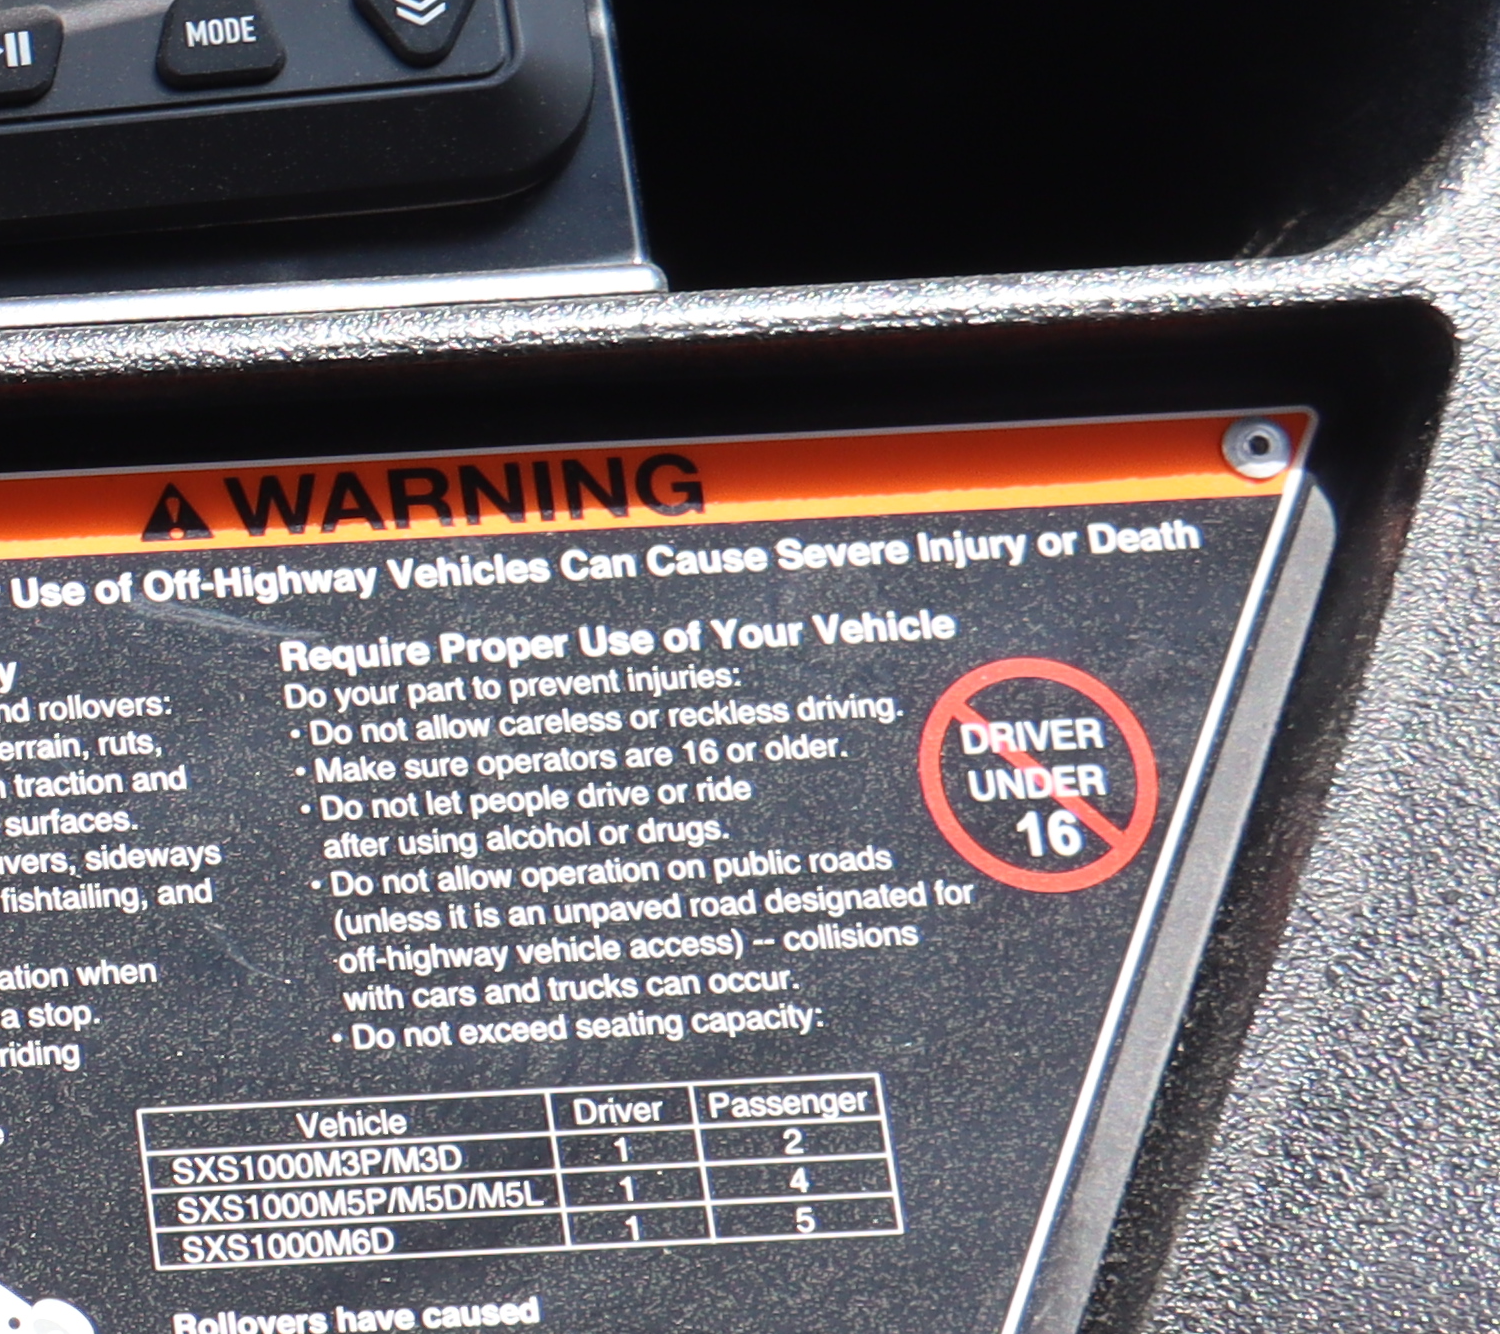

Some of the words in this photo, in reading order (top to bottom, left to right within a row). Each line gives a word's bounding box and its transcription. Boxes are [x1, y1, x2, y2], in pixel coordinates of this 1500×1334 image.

[185, 15, 256, 47] MODE
[222, 452, 706, 537] WARNING
[11, 577, 85, 609] Use
[95, 572, 133, 604] of
[143, 565, 377, 604] Off-Highway
[387, 553, 551, 589] Vehicles
[561, 549, 637, 581] Can
[647, 545, 768, 576] Cause
[776, 538, 909, 570] Severe
[917, 530, 1026, 569] Injury
[1037, 532, 1077, 557] or
[1087, 520, 1200, 554] Death
[280, 636, 430, 676] Require
[439, 633, 568, 668] Proper
[579, 625, 654, 657] Use
[663, 620, 701, 653] of
[710, 618, 803, 649] Your
[812, 609, 955, 644] Vehicle
[39, 694, 174, 721] rollovers:
[284, 683, 327, 709] Do
[334, 684, 399, 713] your
[408, 677, 466, 709] part
[472, 676, 501, 700] to
[509, 669, 620, 704] prevent
[628, 668, 741, 697] injuries:
[98, 731, 162, 757] ruts,
[310, 720, 352, 745] Do
[361, 718, 408, 743] not
[416, 714, 490, 741] allow
[499, 708, 622, 736] careless
[630, 709, 659, 730] or
[668, 700, 790, 727] reckless
[797, 695, 903, 724] driving.
[959, 717, 1104, 755] DRIVER
[315, 756, 396, 783] Make
[404, 757, 468, 779] sure
[477, 747, 617, 780] operators
[625, 746, 673, 768] are
[683, 739, 719, 764] 16
[727, 742, 756, 763] or
[765, 734, 847, 761] older.
[967, 764, 1108, 802] UNDER
[1016, 809, 1084, 857] 16
[85, 844, 222, 872] sideways
[76, 959, 157, 986] when
[295, 1109, 408, 1140] Vehicle
[572, 1097, 663, 1126] Driver
[707, 1090, 868, 1120] Passenger
[172, 1144, 464, 1185] SXS1000M3P/M3D
[613, 1137, 629, 1162] 1
[782, 1128, 804, 1155] 2
[176, 1180, 544, 1224] SXS1000M5P/M5D/M5L
[619, 1176, 634, 1202] 1
[789, 1167, 809, 1193] 4
[182, 1226, 395, 1264] SXS1000M6D
[625, 1216, 640, 1241] 1
[795, 1207, 816, 1233] 5
[336, 1306, 415, 1333] have
[422, 1296, 540, 1329] caused
